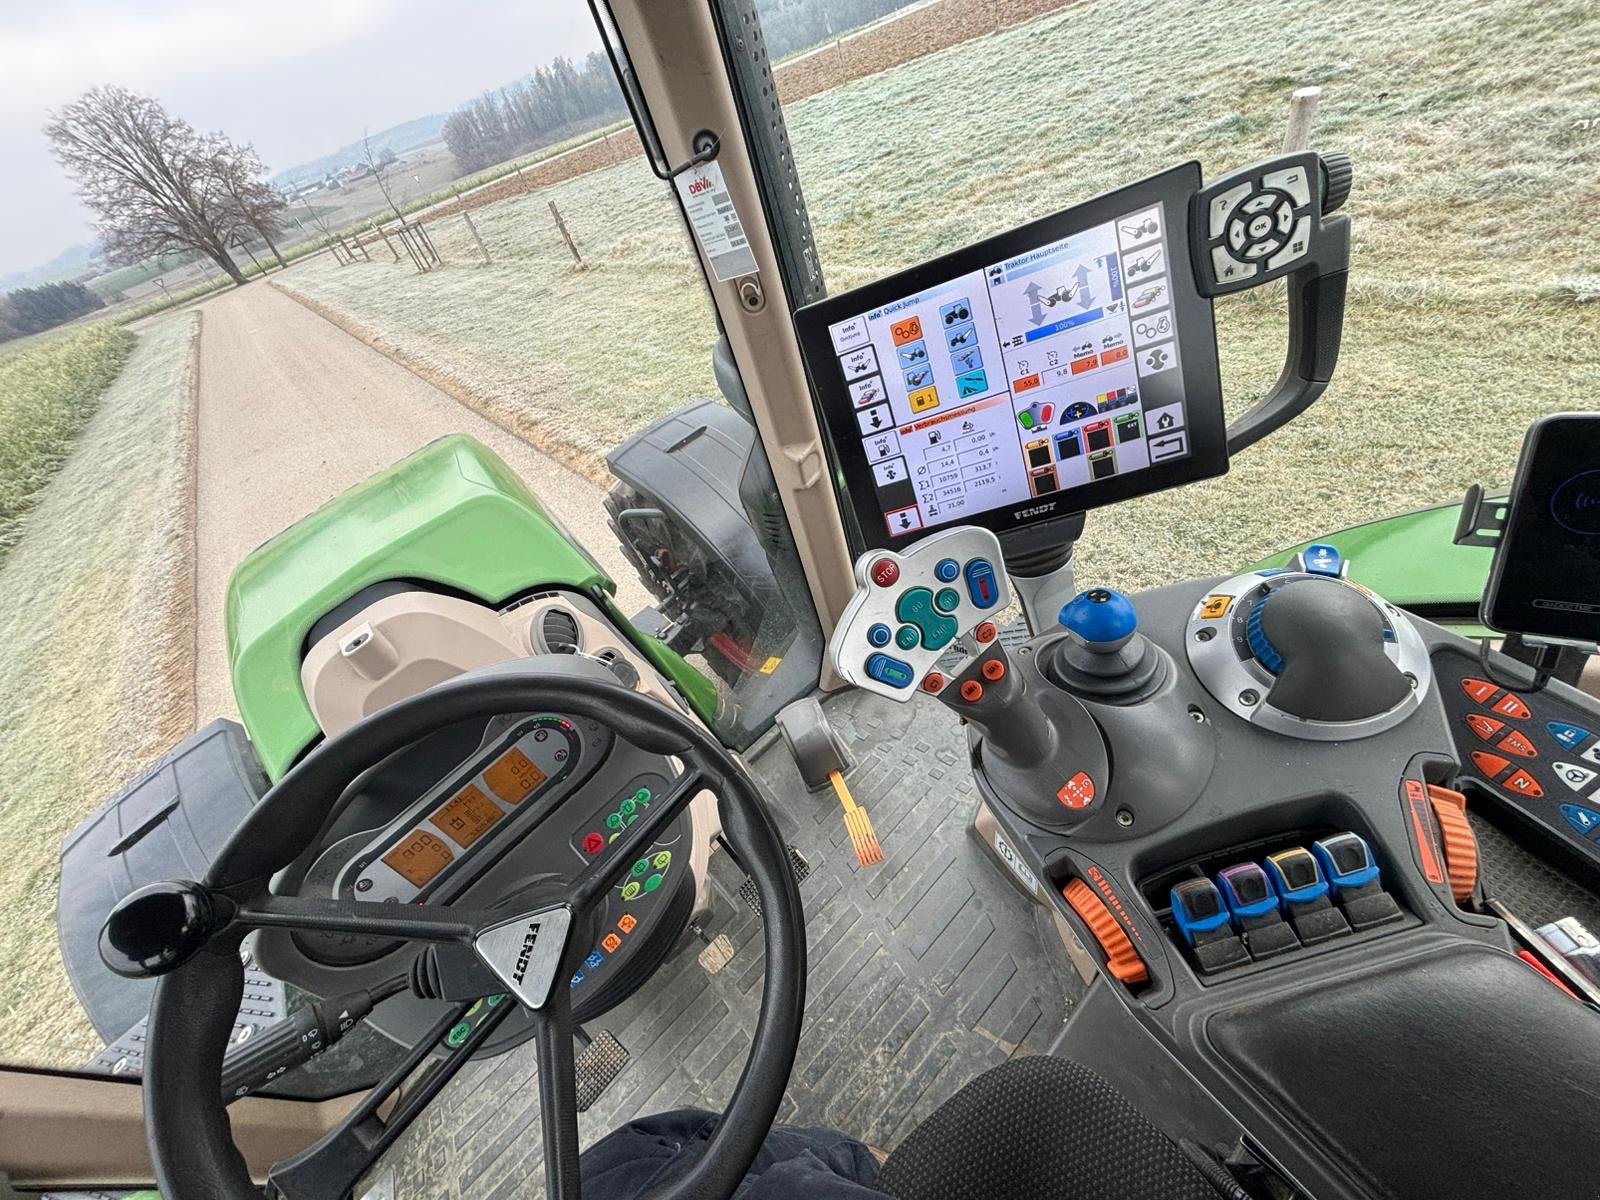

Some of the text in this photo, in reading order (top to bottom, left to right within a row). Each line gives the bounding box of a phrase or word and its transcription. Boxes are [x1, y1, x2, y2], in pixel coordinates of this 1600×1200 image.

[1254, 221, 1267, 231] OK
[1004, 242, 1069, 271] Traktor Hauptseite
[883, 303, 903, 315] Quick
[902, 297, 920, 309] Jump
[1054, 319, 1075, 331] 100%
[1103, 340, 1124, 349] Memo
[1073, 349, 1094, 359] Memo
[1049, 359, 1059, 367] C2
[1020, 368, 1030, 376] C1
[928, 394, 933, 402] 1
[914, 407, 977, 431] Verbrauchsmessung
[1014, 501, 1057, 520] FENDT
[877, 563, 896, 583] STOP
[1506, 737, 1528, 752] TMS
[1513, 777, 1530, 789] N
[512, 922, 541, 986] FENDT
[453, 1026, 467, 1040] ESC
